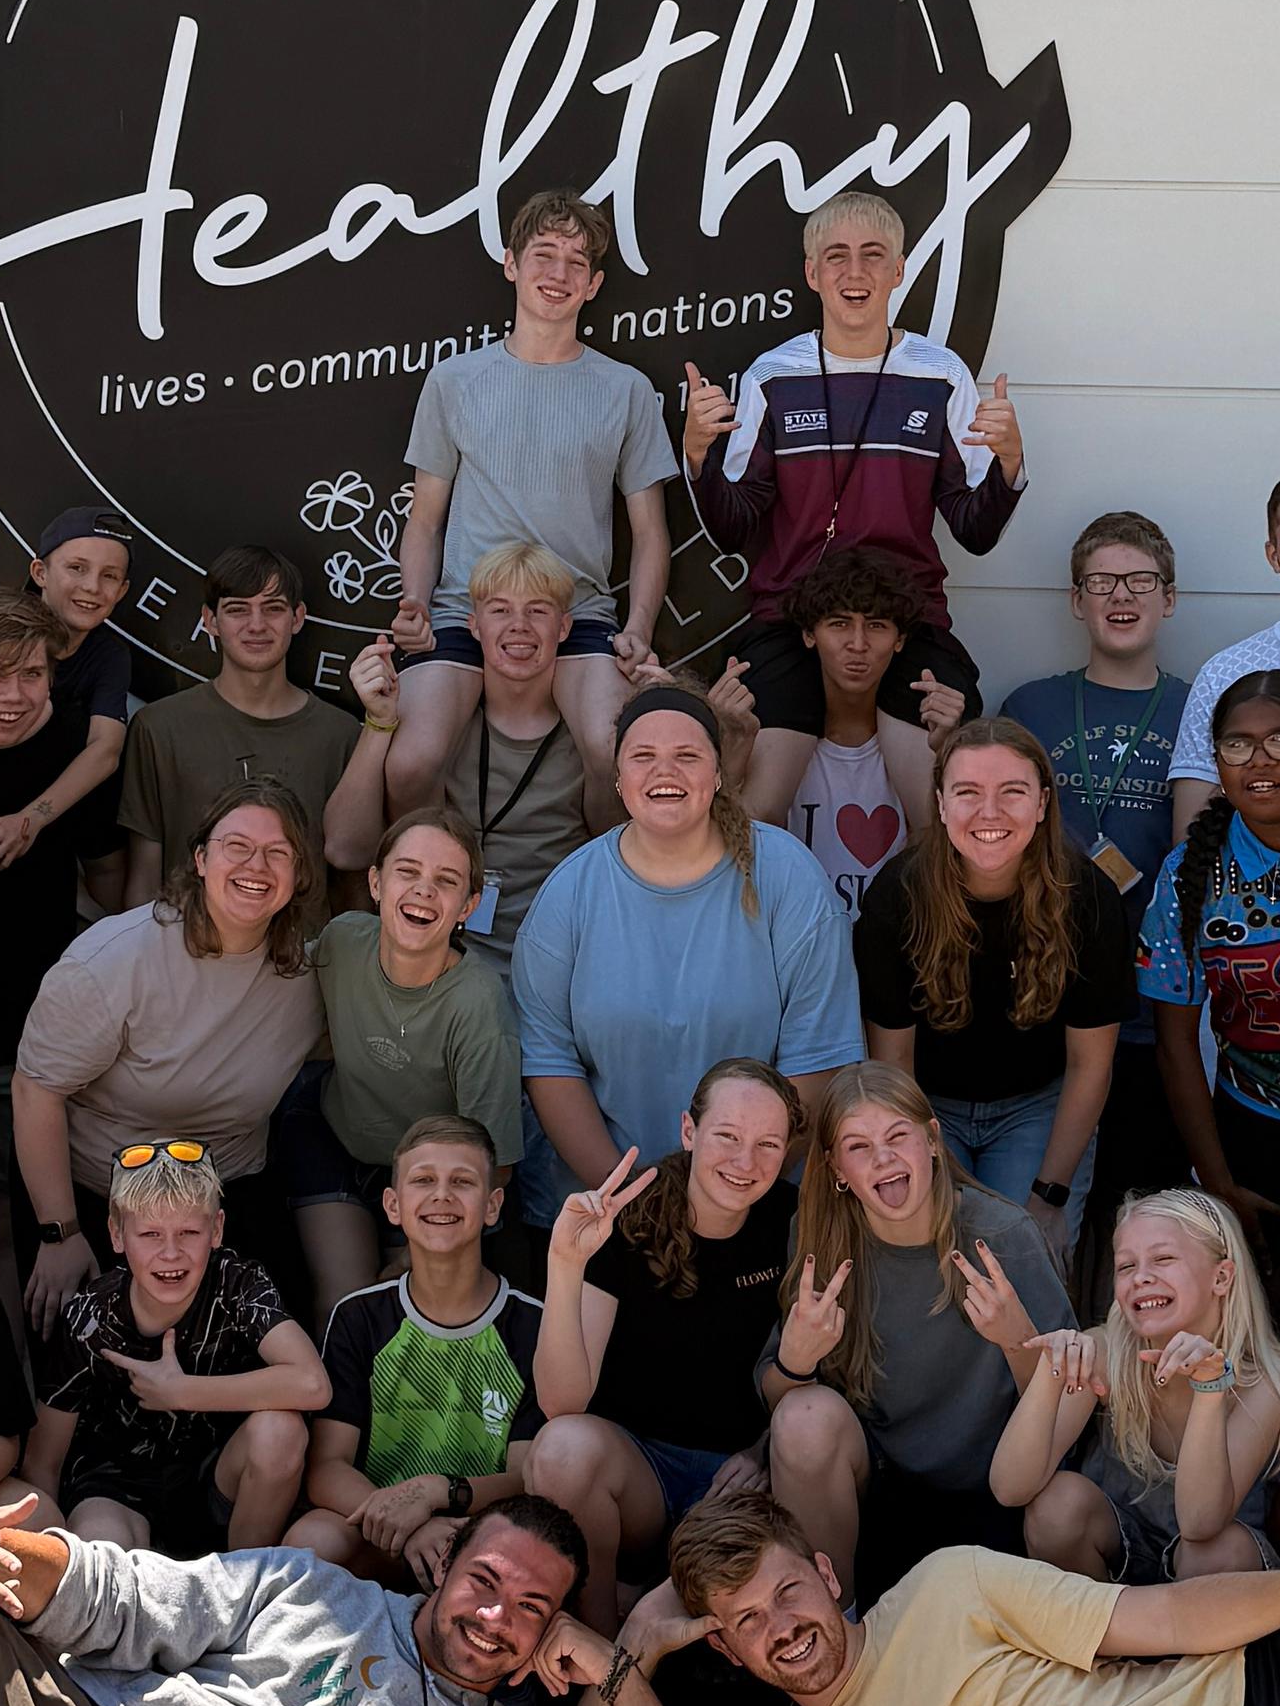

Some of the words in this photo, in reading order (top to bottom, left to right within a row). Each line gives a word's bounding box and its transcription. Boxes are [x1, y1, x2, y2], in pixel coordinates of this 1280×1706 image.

[99, 372, 207, 415] lives
[612, 288, 794, 342] nations
[1119, 801, 1153, 810] BEACH
